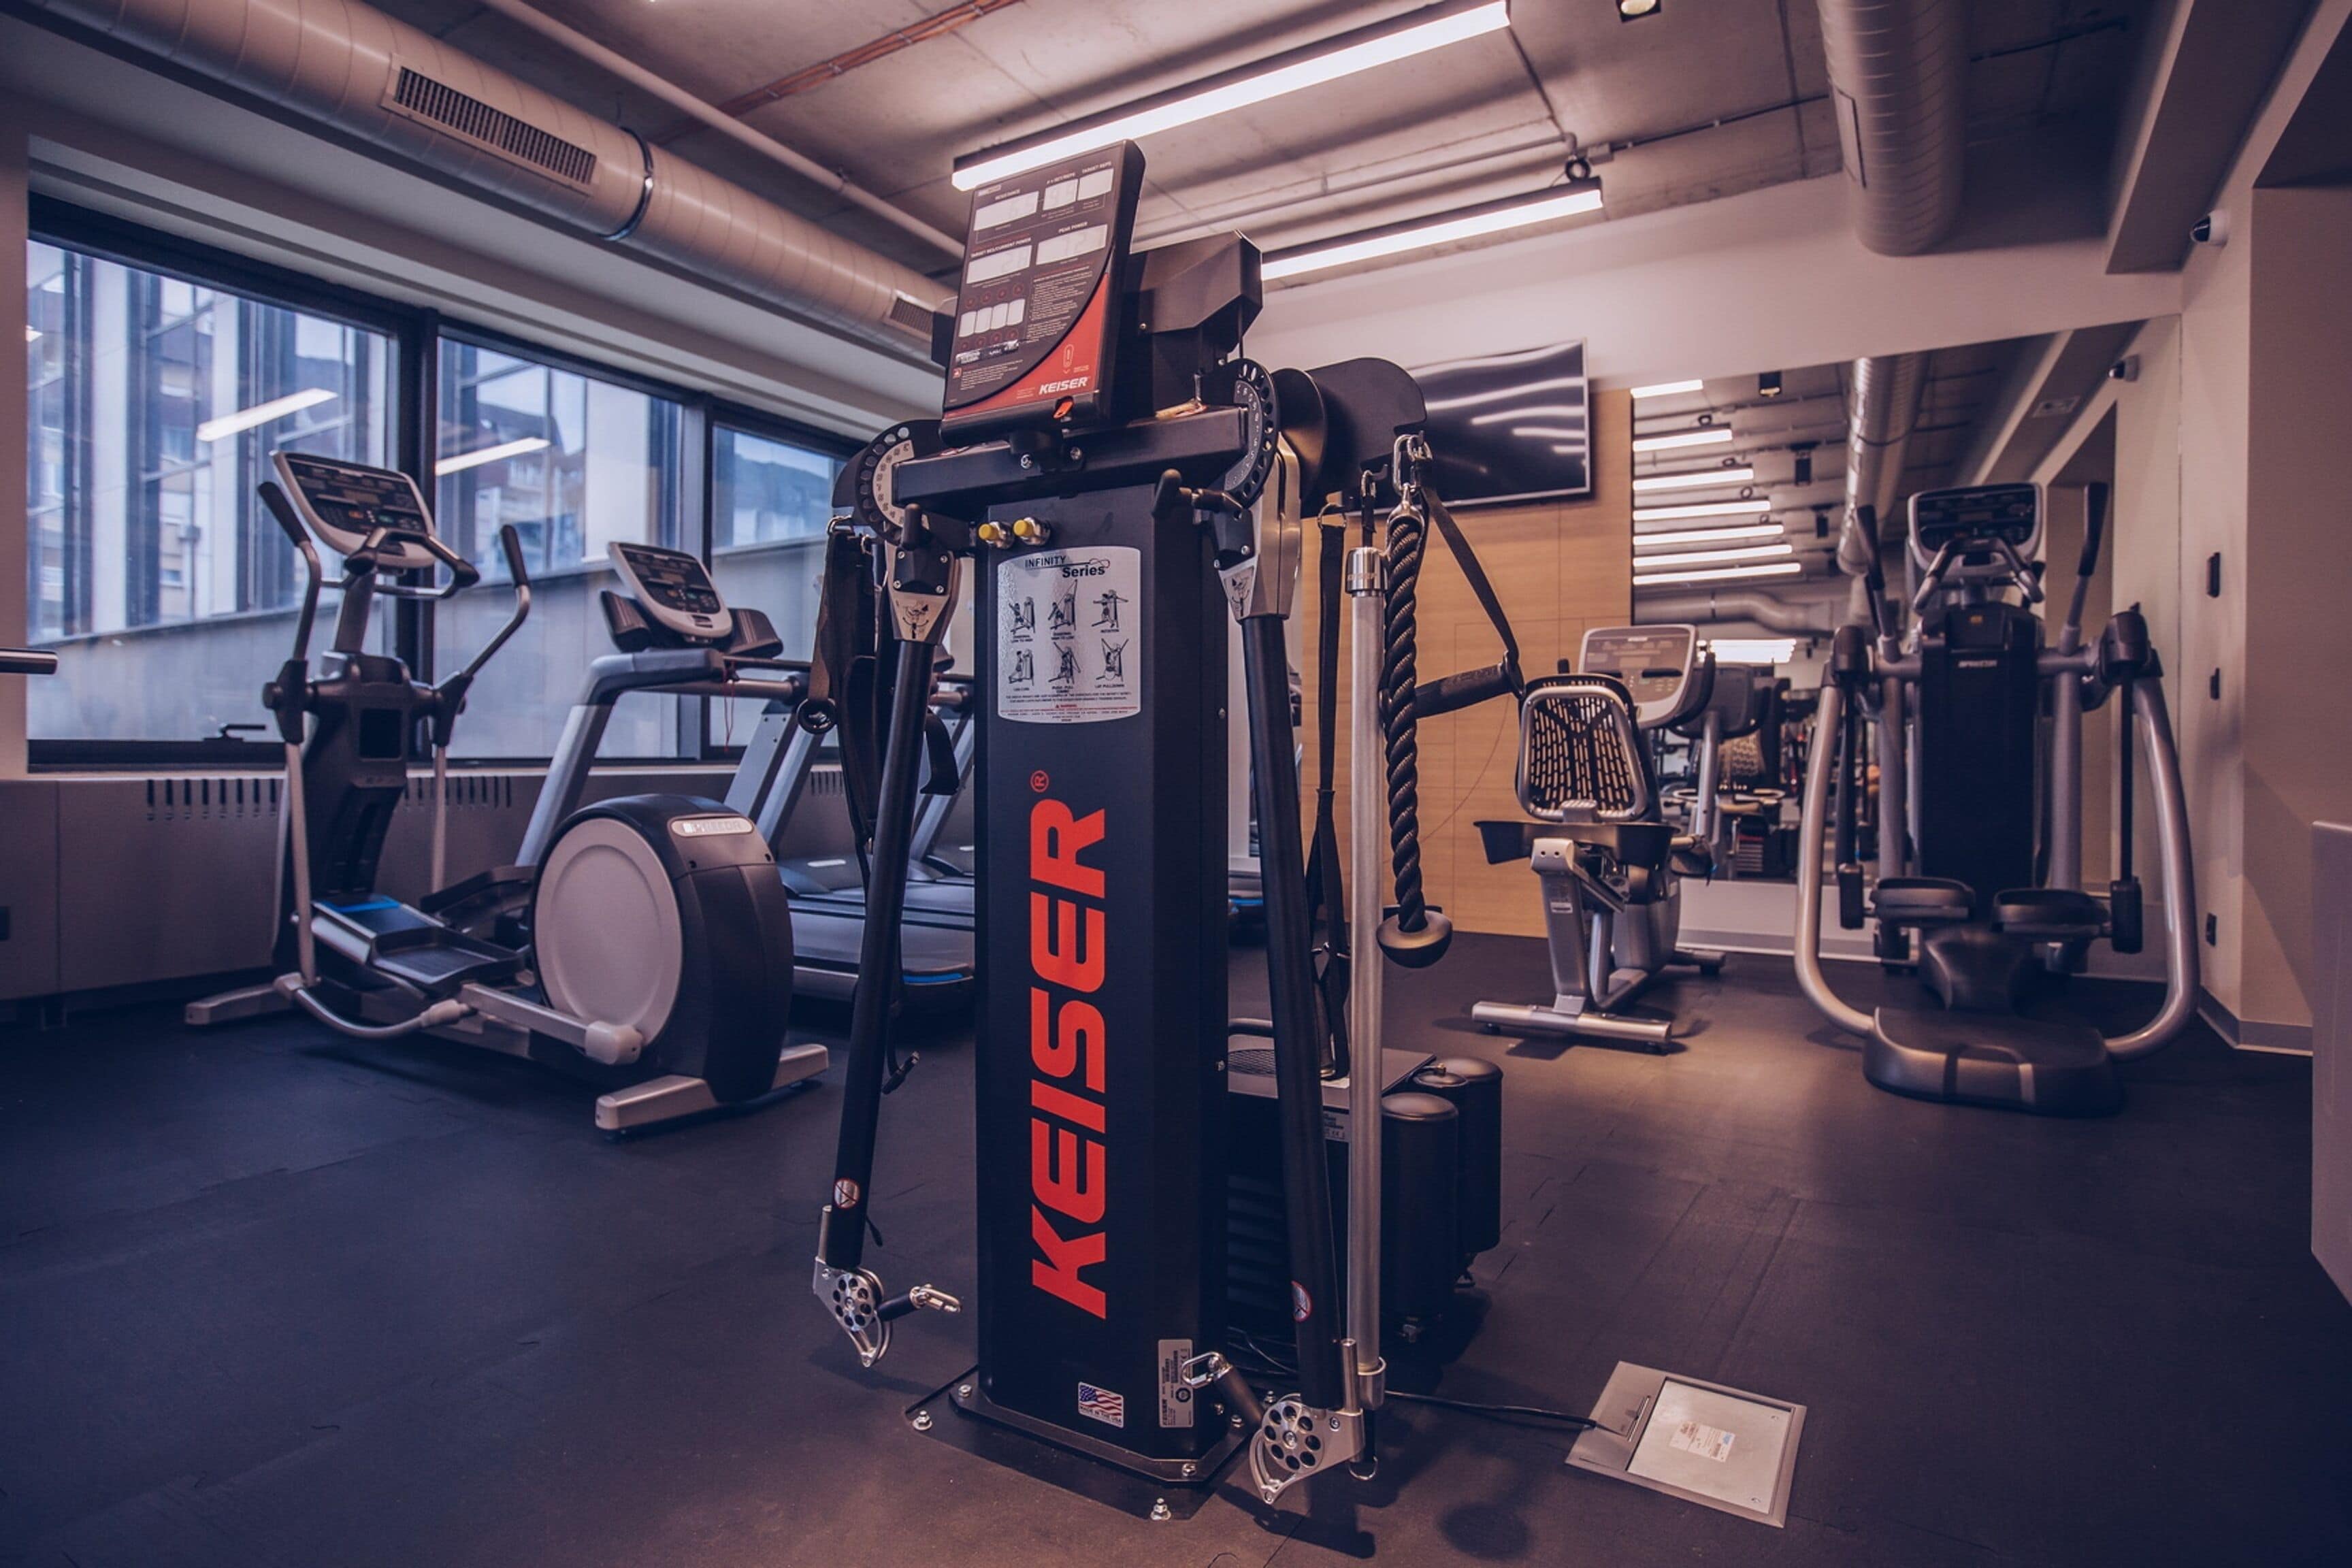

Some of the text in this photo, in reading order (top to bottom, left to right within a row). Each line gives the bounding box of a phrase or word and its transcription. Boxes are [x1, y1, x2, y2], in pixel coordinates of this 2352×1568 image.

[1039, 376, 1089, 395] KEISER
[1025, 555, 1066, 568] INFINITY
[1062, 566, 1105, 578] Series
